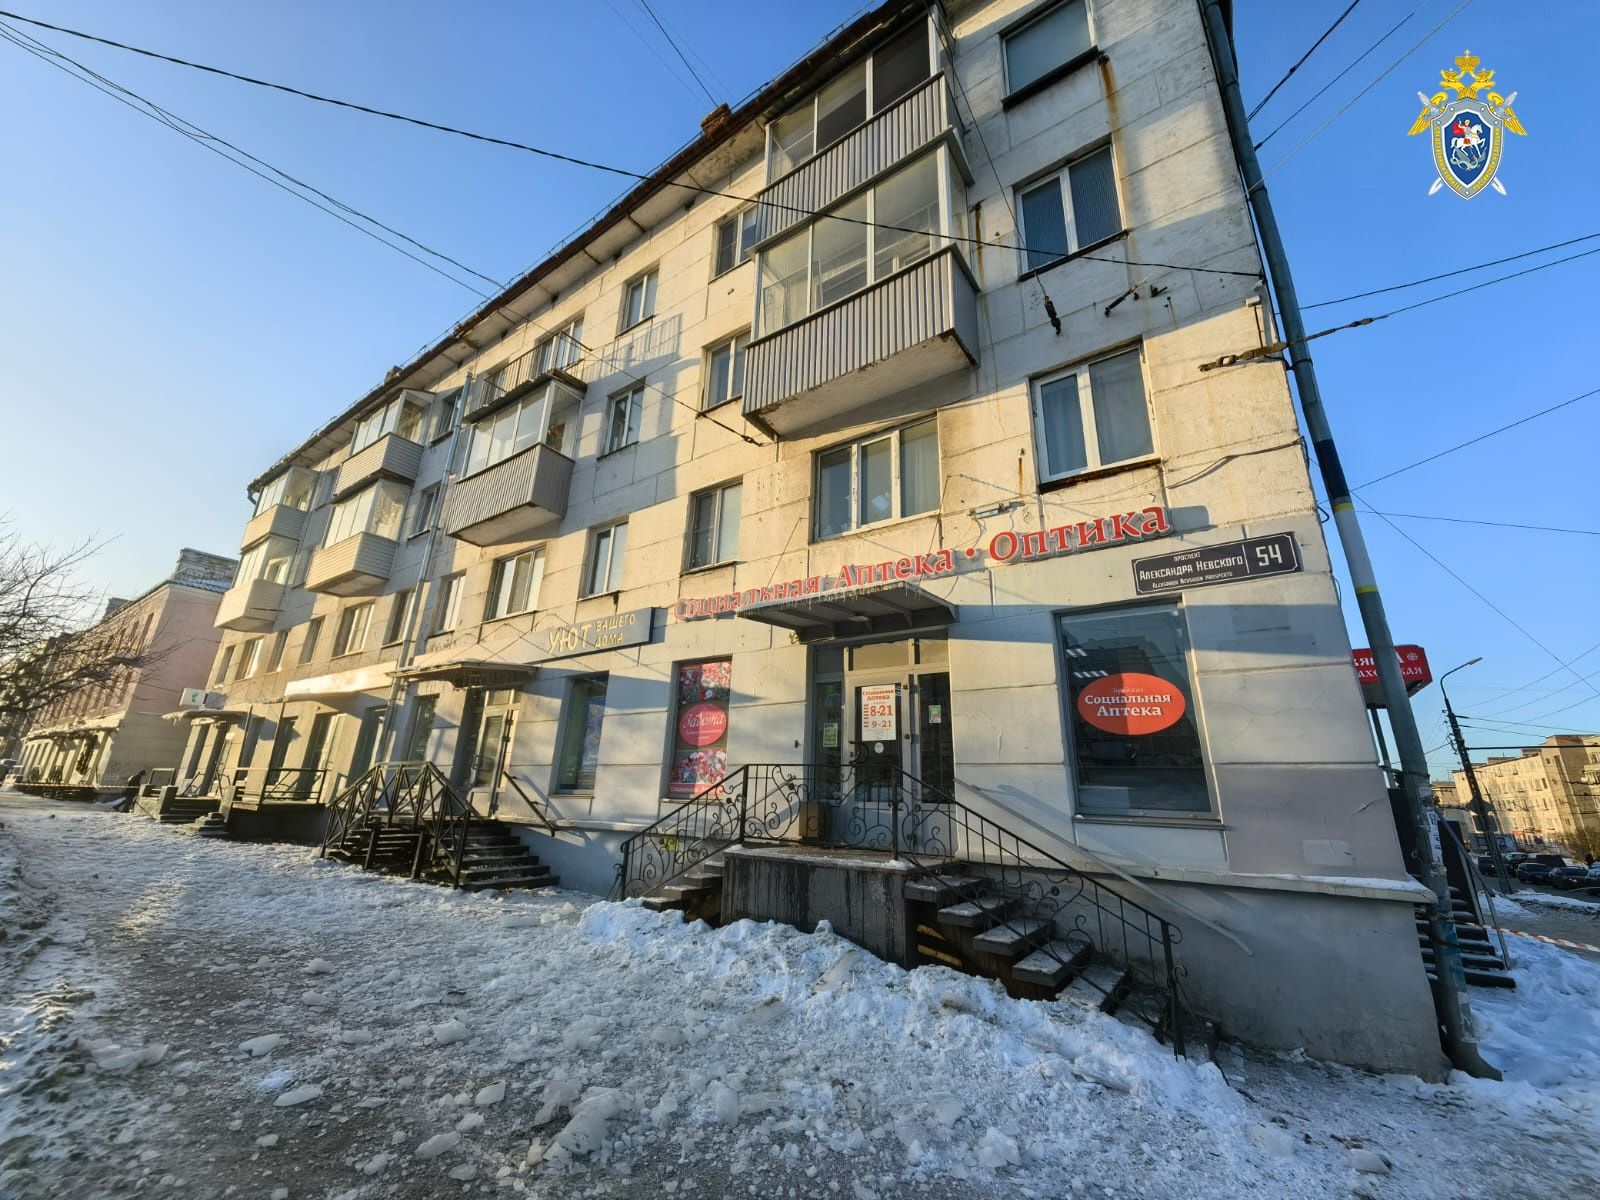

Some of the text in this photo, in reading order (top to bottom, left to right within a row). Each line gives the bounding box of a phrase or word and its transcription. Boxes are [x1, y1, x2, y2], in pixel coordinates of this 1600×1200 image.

[674, 506, 1169, 620] Социальная Аптека Оптика
[1255, 543, 1283, 567] 54
[596, 614, 636, 632] ВАШЕГО
[549, 624, 592, 655] УЮТ
[595, 632, 624, 648] ДОМА
[1085, 693, 1171, 705] Социальная
[870, 704, 894, 717] 8-21
[1097, 705, 1162, 717] Аптека
